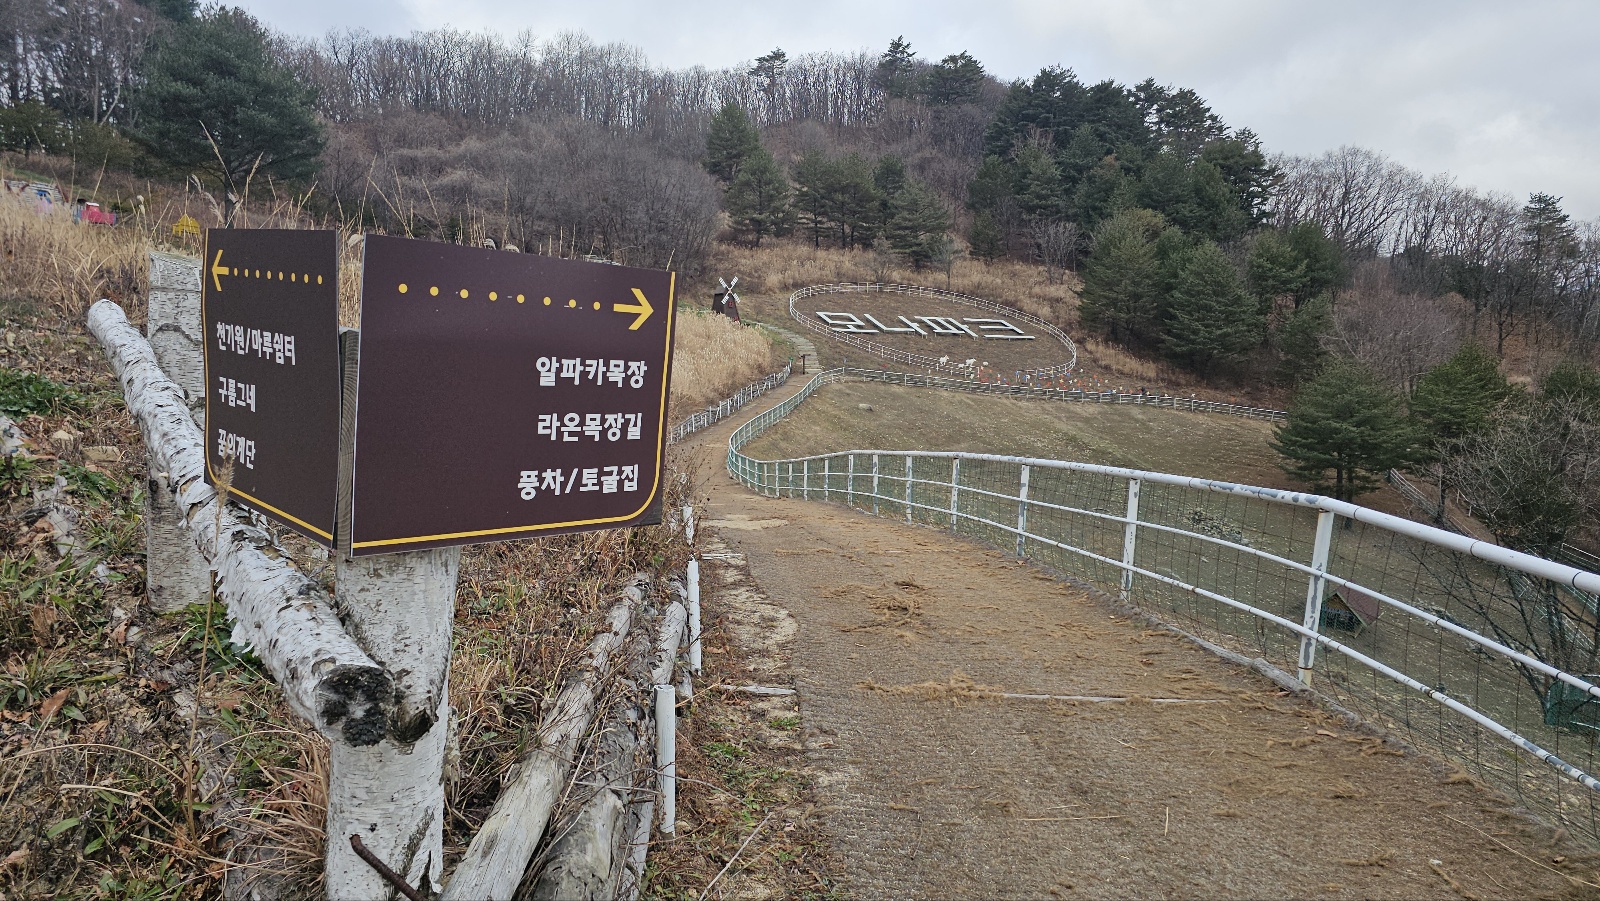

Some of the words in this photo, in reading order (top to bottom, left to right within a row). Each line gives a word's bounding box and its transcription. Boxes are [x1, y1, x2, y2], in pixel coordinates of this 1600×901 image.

[216, 321, 296, 366] 천기원/마루쉼터
[816, 311, 1036, 339] 모나파크
[535, 356, 648, 389] 알파카목장
[218, 376, 256, 413] 구름그네
[537, 412, 643, 442] 라온목장길
[217, 428, 256, 470] 꿈의계단
[517, 463, 639, 501] 풍차/토굴집
